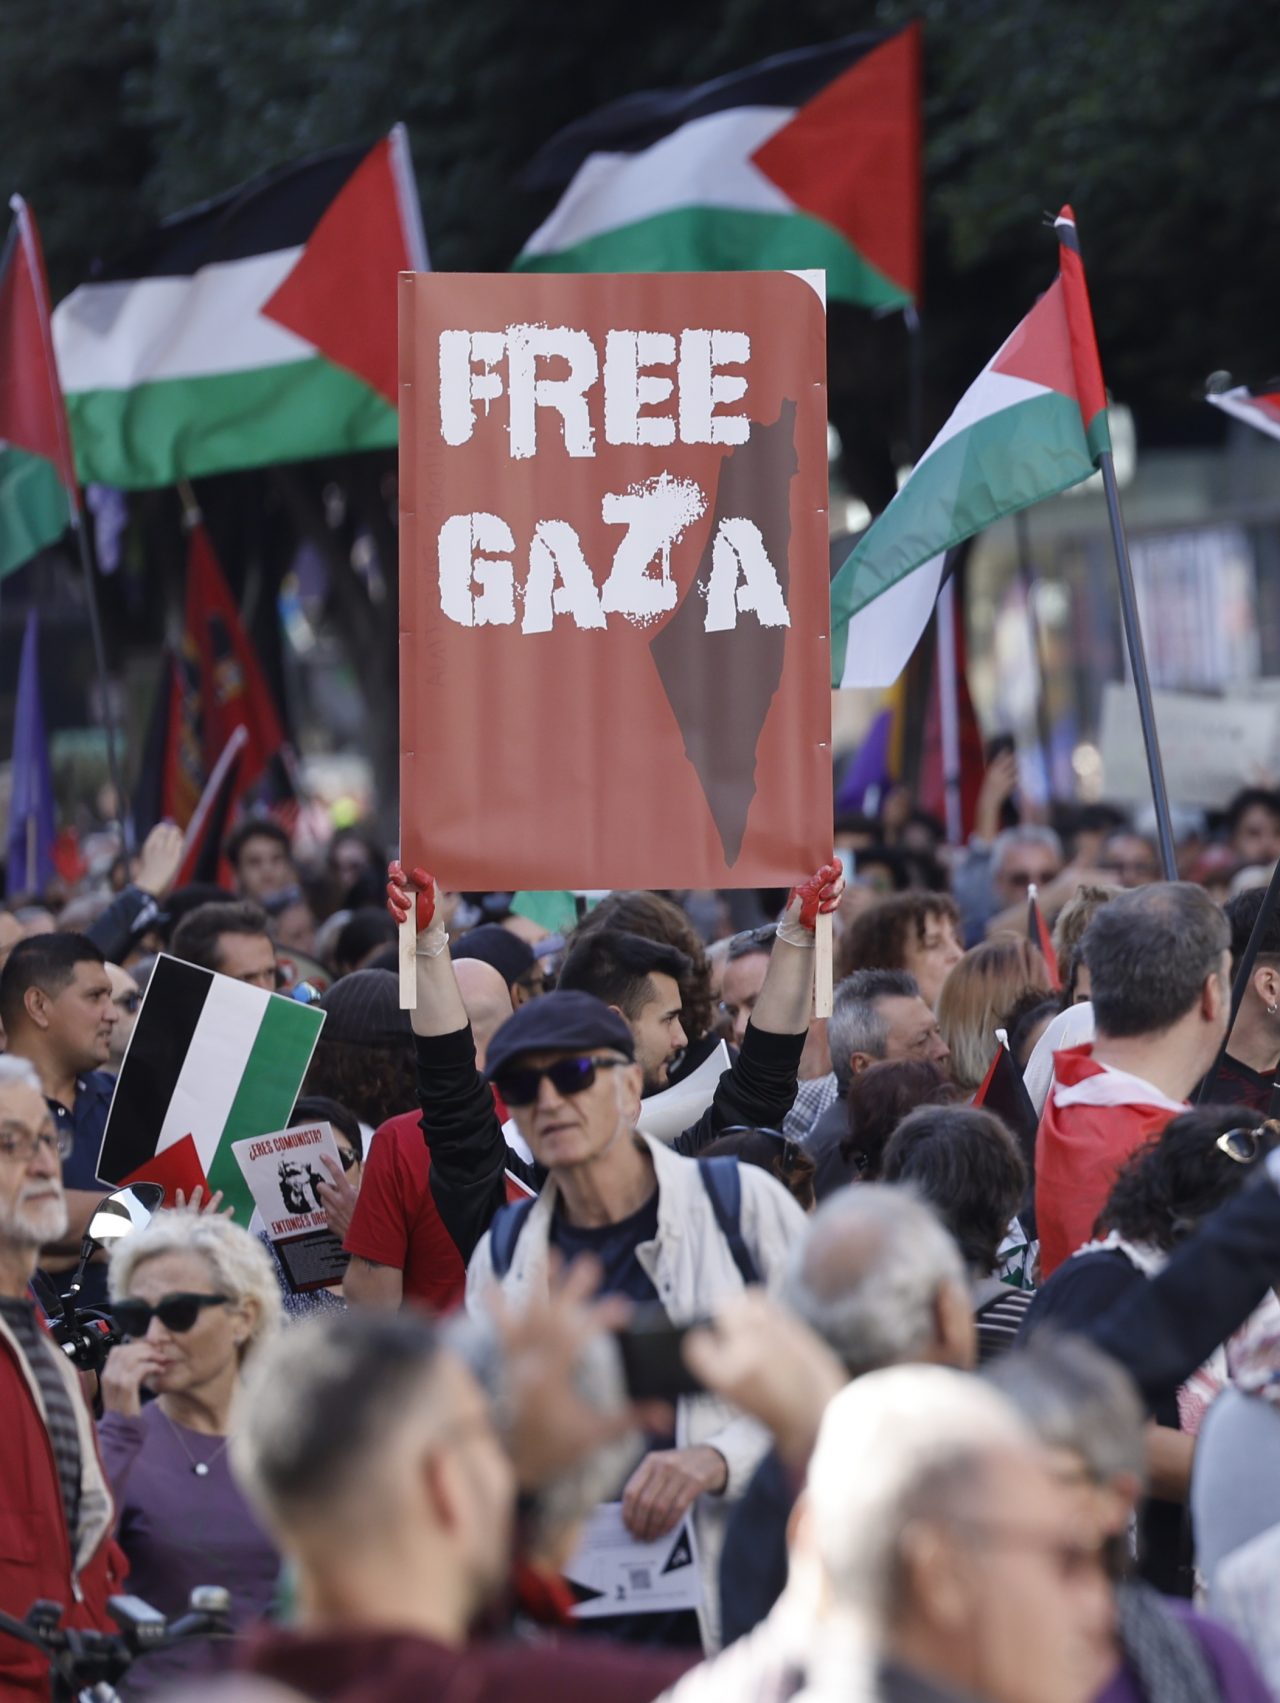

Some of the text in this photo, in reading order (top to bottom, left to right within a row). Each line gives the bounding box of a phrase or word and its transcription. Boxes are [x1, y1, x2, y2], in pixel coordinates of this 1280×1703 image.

[438, 321, 751, 459] FREE
[437, 470, 791, 634] GAZA
[249, 1129, 322, 1160] ¿ERES COMUNISTA?
[271, 1214, 311, 1234] ENTONCES
